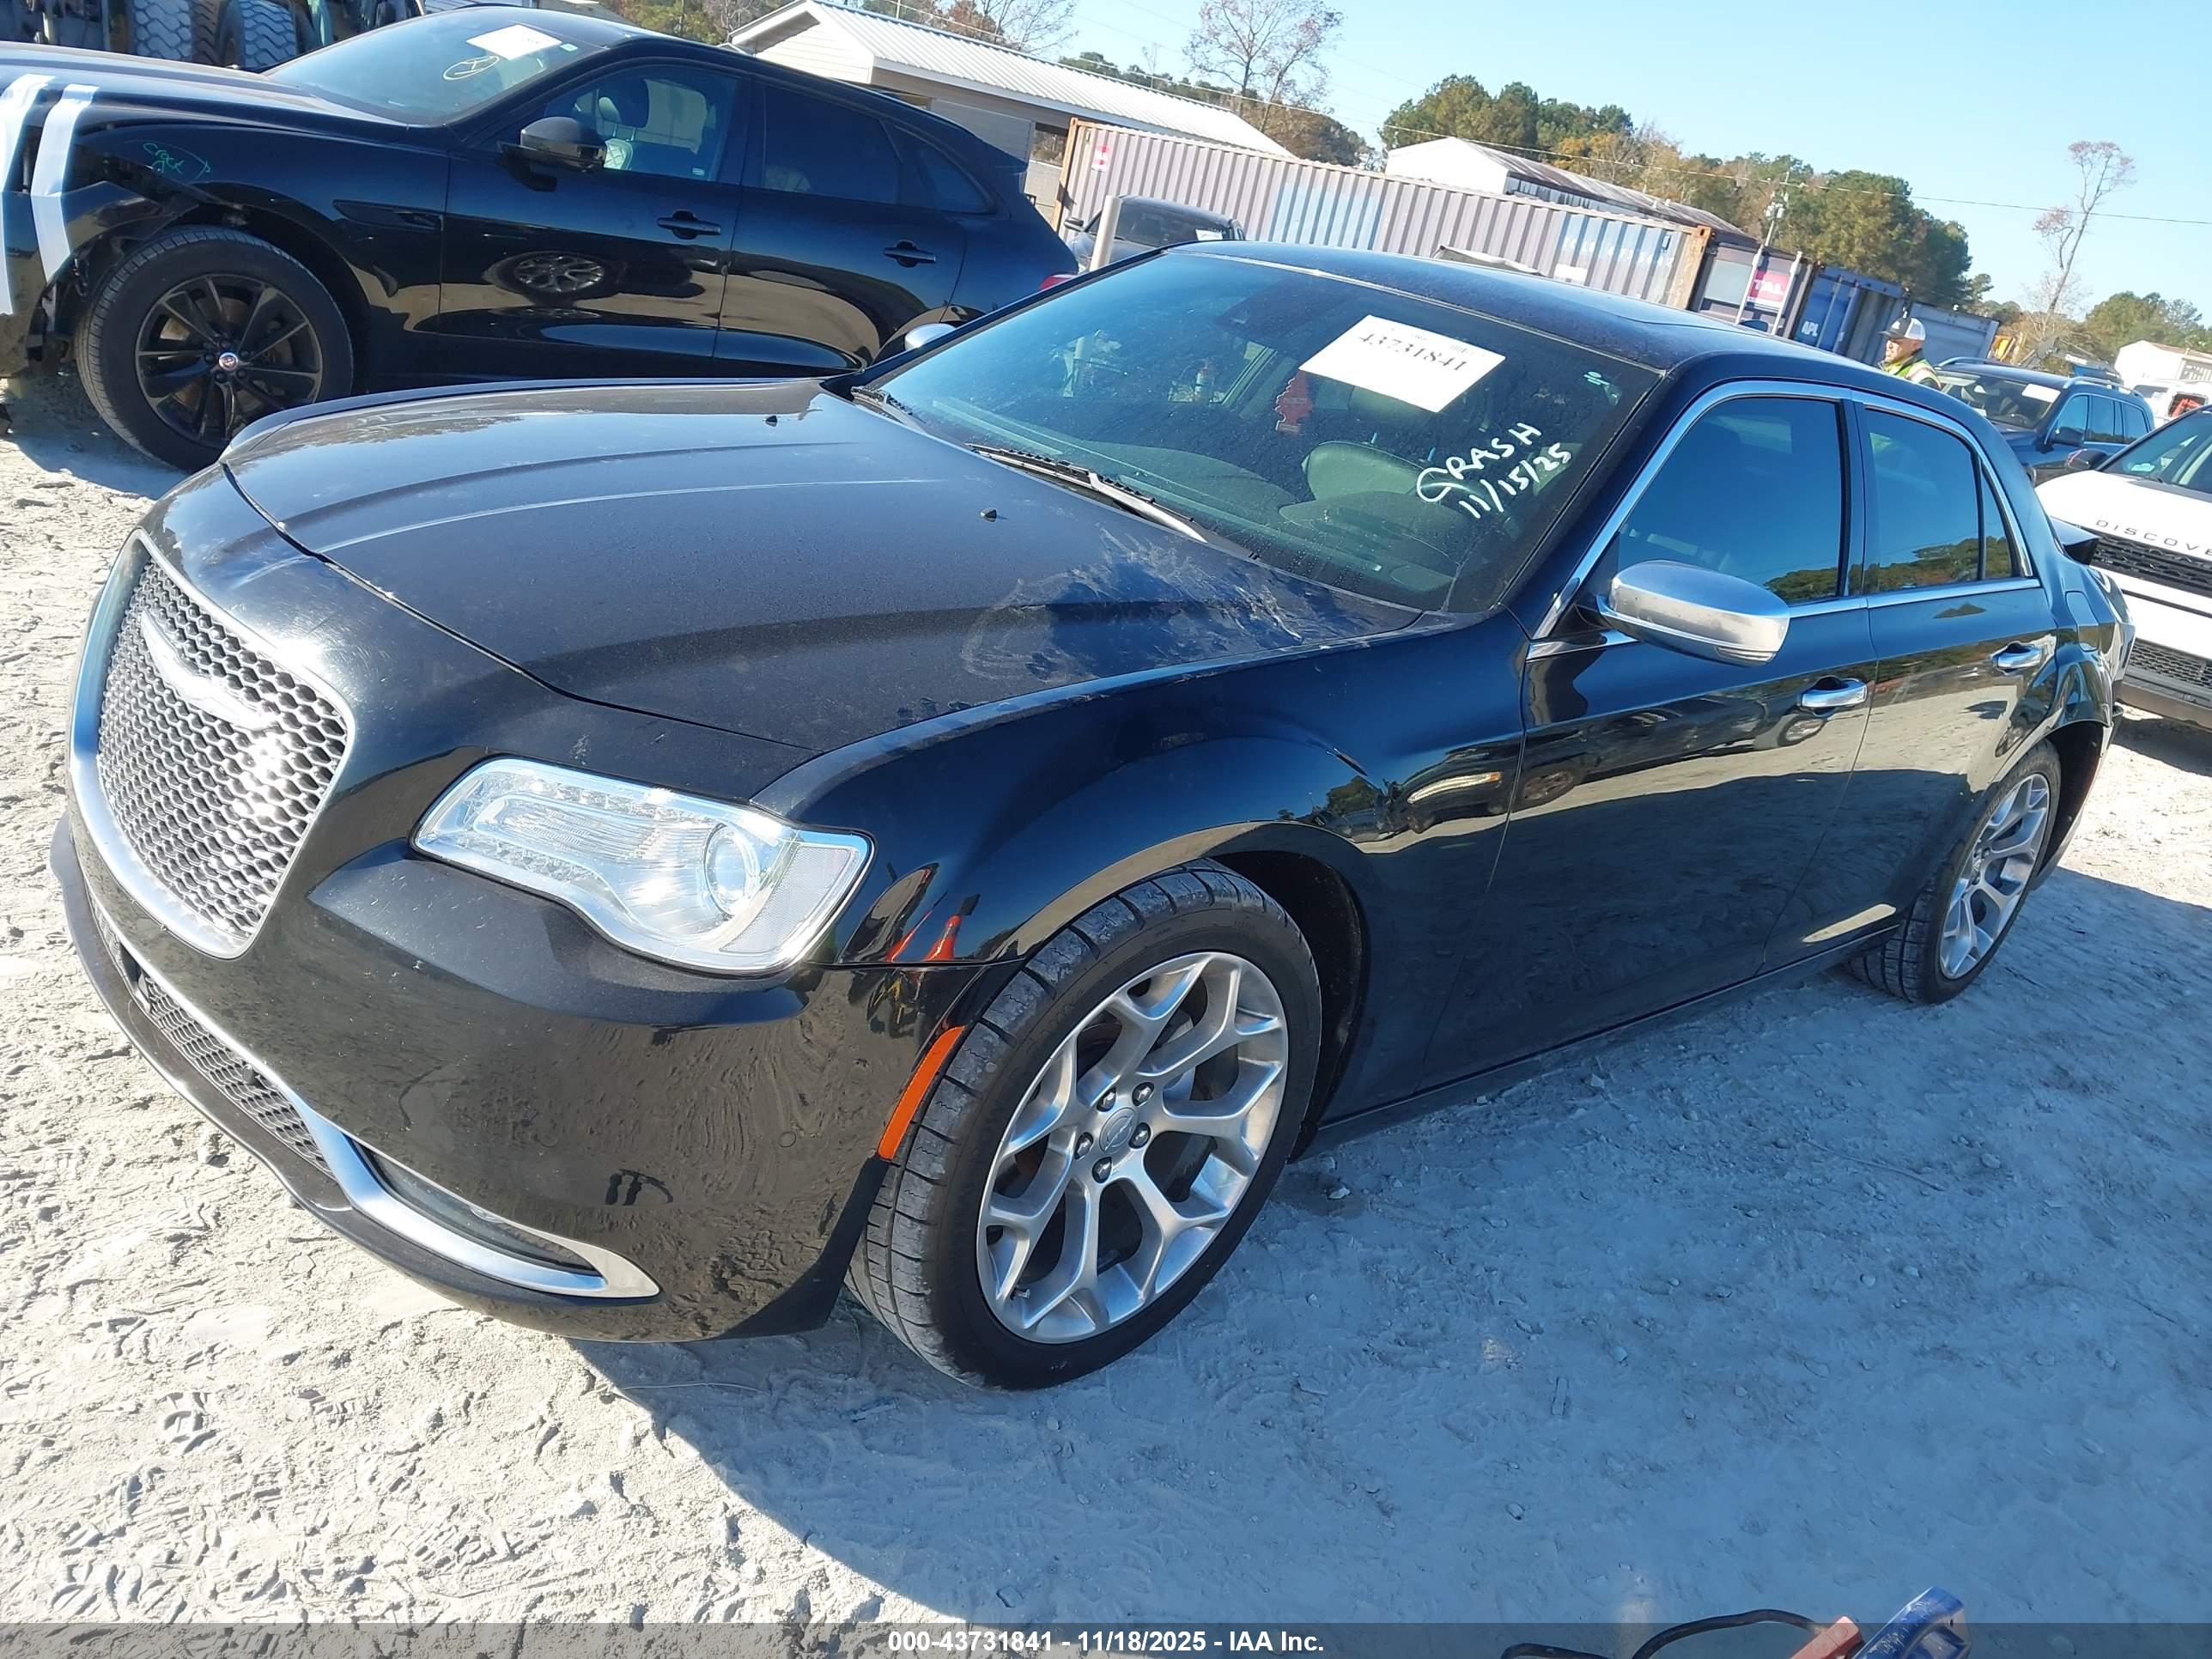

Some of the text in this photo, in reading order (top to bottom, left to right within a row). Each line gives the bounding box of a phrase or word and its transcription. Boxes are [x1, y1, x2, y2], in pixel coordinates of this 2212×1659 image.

[1801, 321, 1820, 337] APL
[1417, 422, 1542, 502] CRASH
[1459, 442, 1571, 520] 11/15/25
